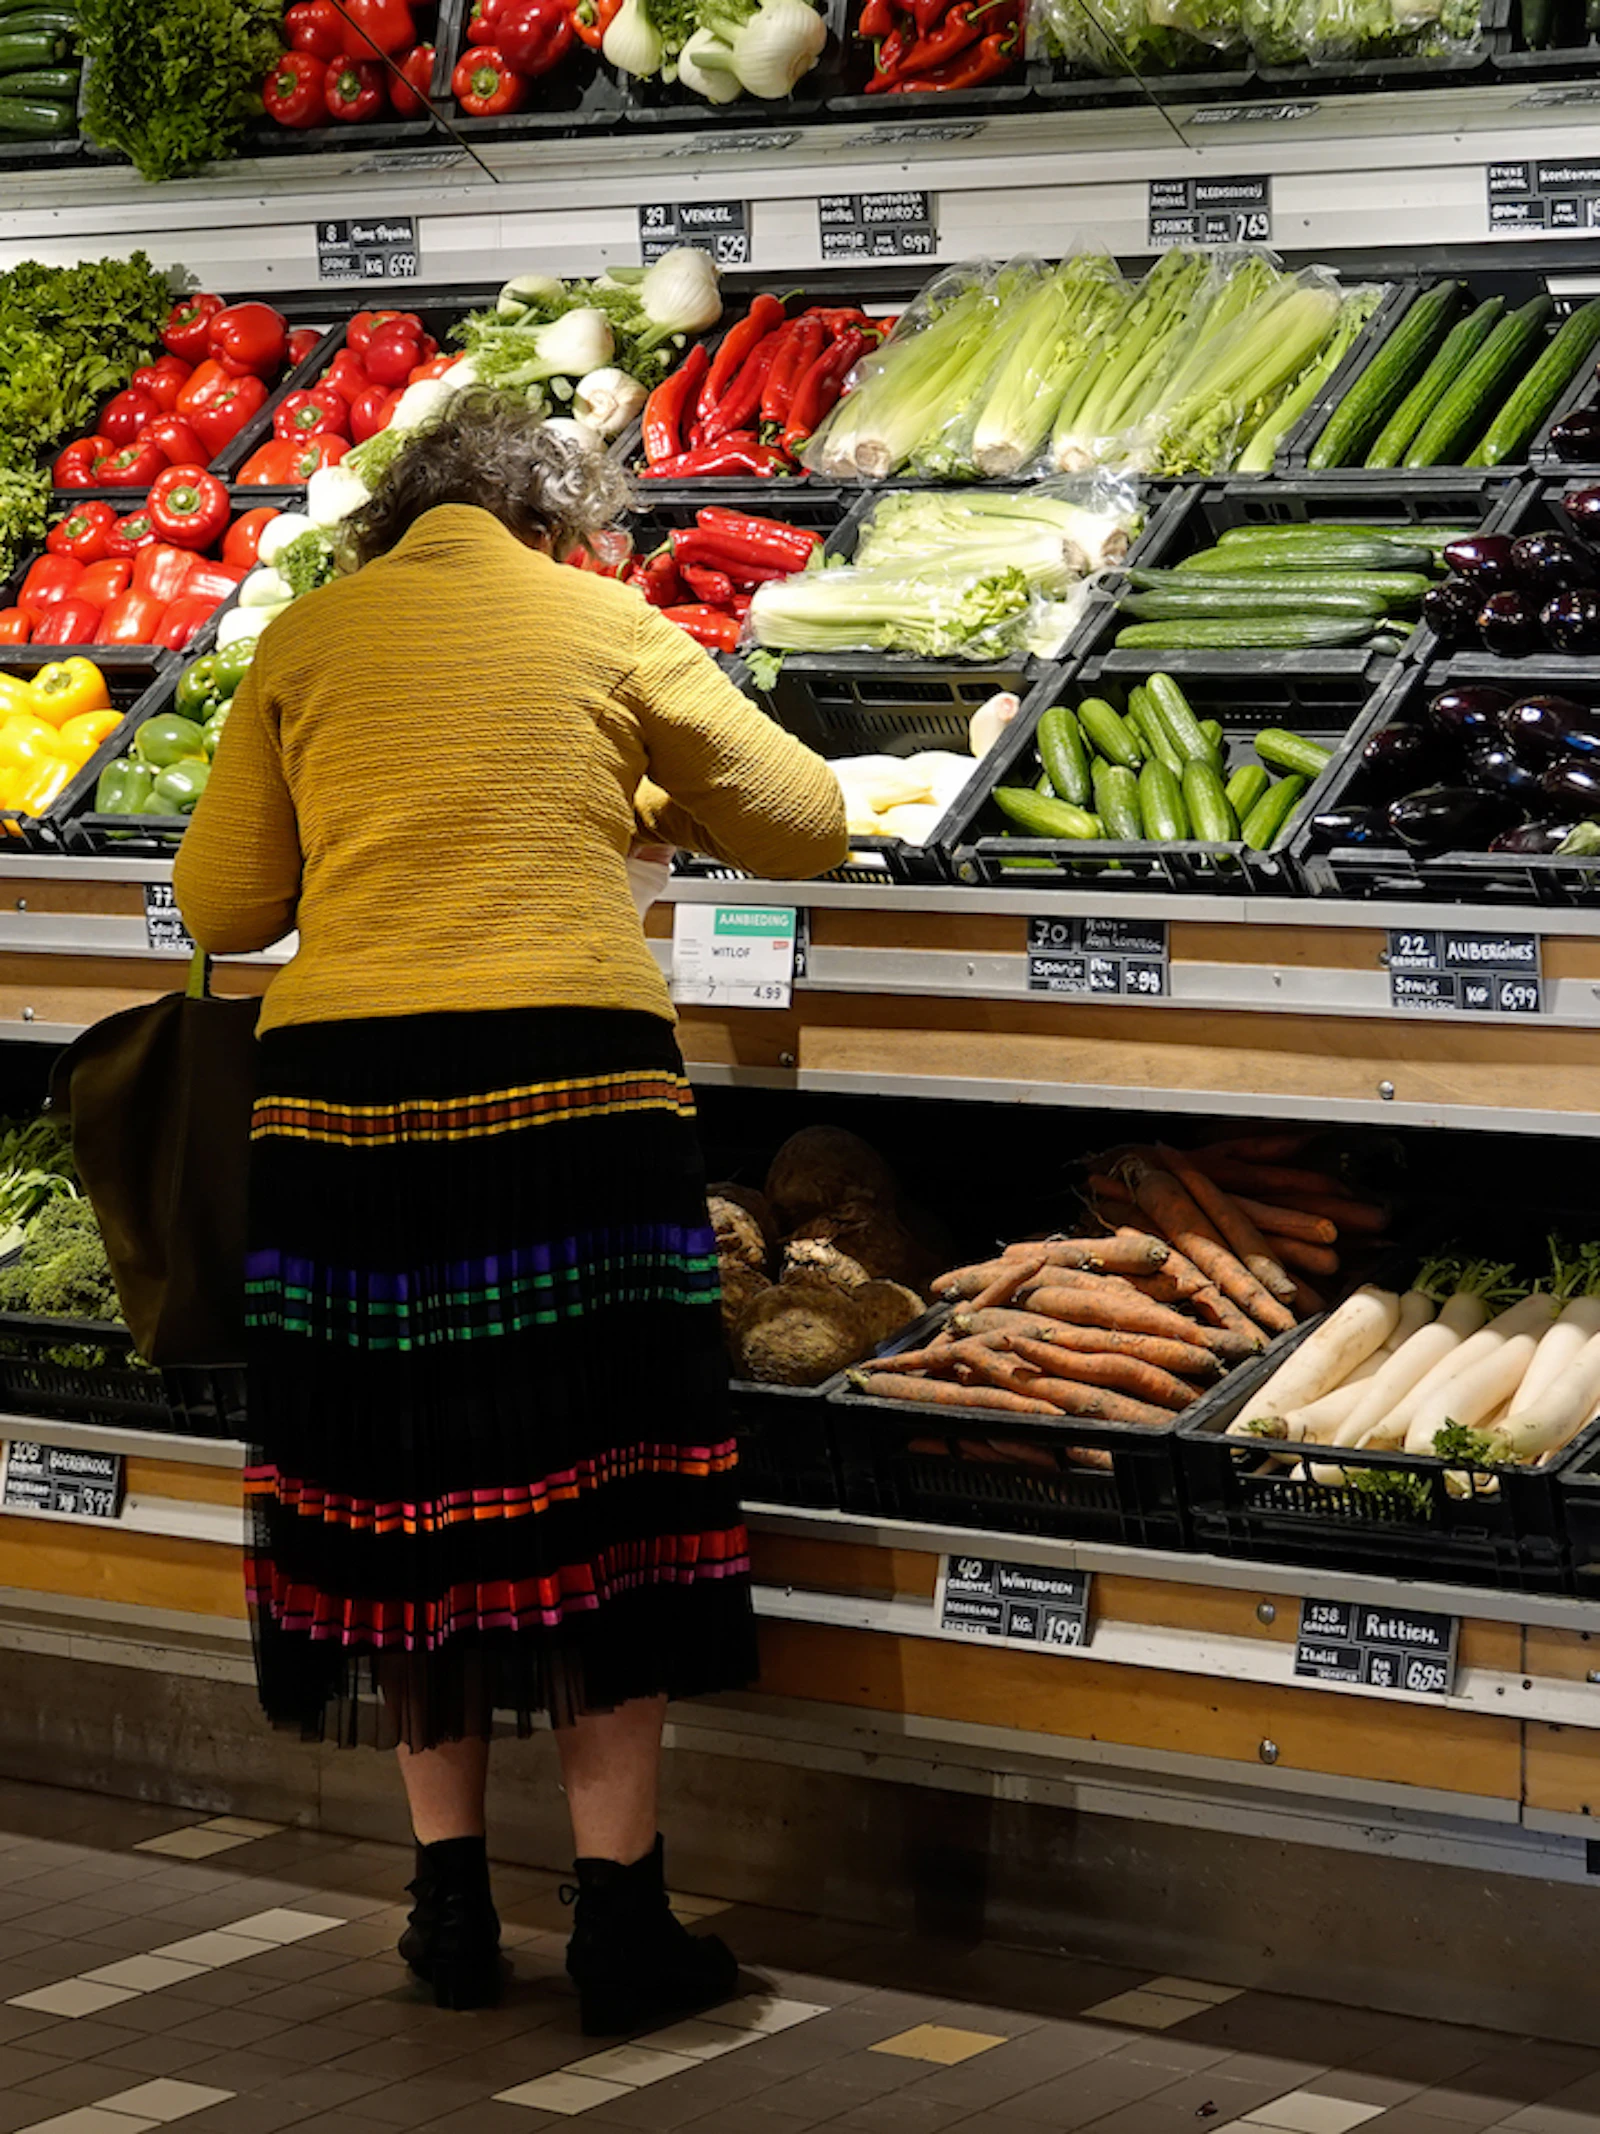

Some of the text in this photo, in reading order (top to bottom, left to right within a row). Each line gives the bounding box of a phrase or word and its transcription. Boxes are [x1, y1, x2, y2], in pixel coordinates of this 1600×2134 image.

[680, 206, 733, 225] VENKEL
[365, 258, 384, 276] KG
[719, 912, 790, 928] AANBIEDING
[711, 947, 751, 958] WITLOF
[1399, 934, 1431, 956] 22
[753, 985, 782, 1000] 4.99
[1465, 986, 1490, 1003] KG
[957, 1558, 983, 1579] 40
[1311, 1605, 1340, 1624] 138
